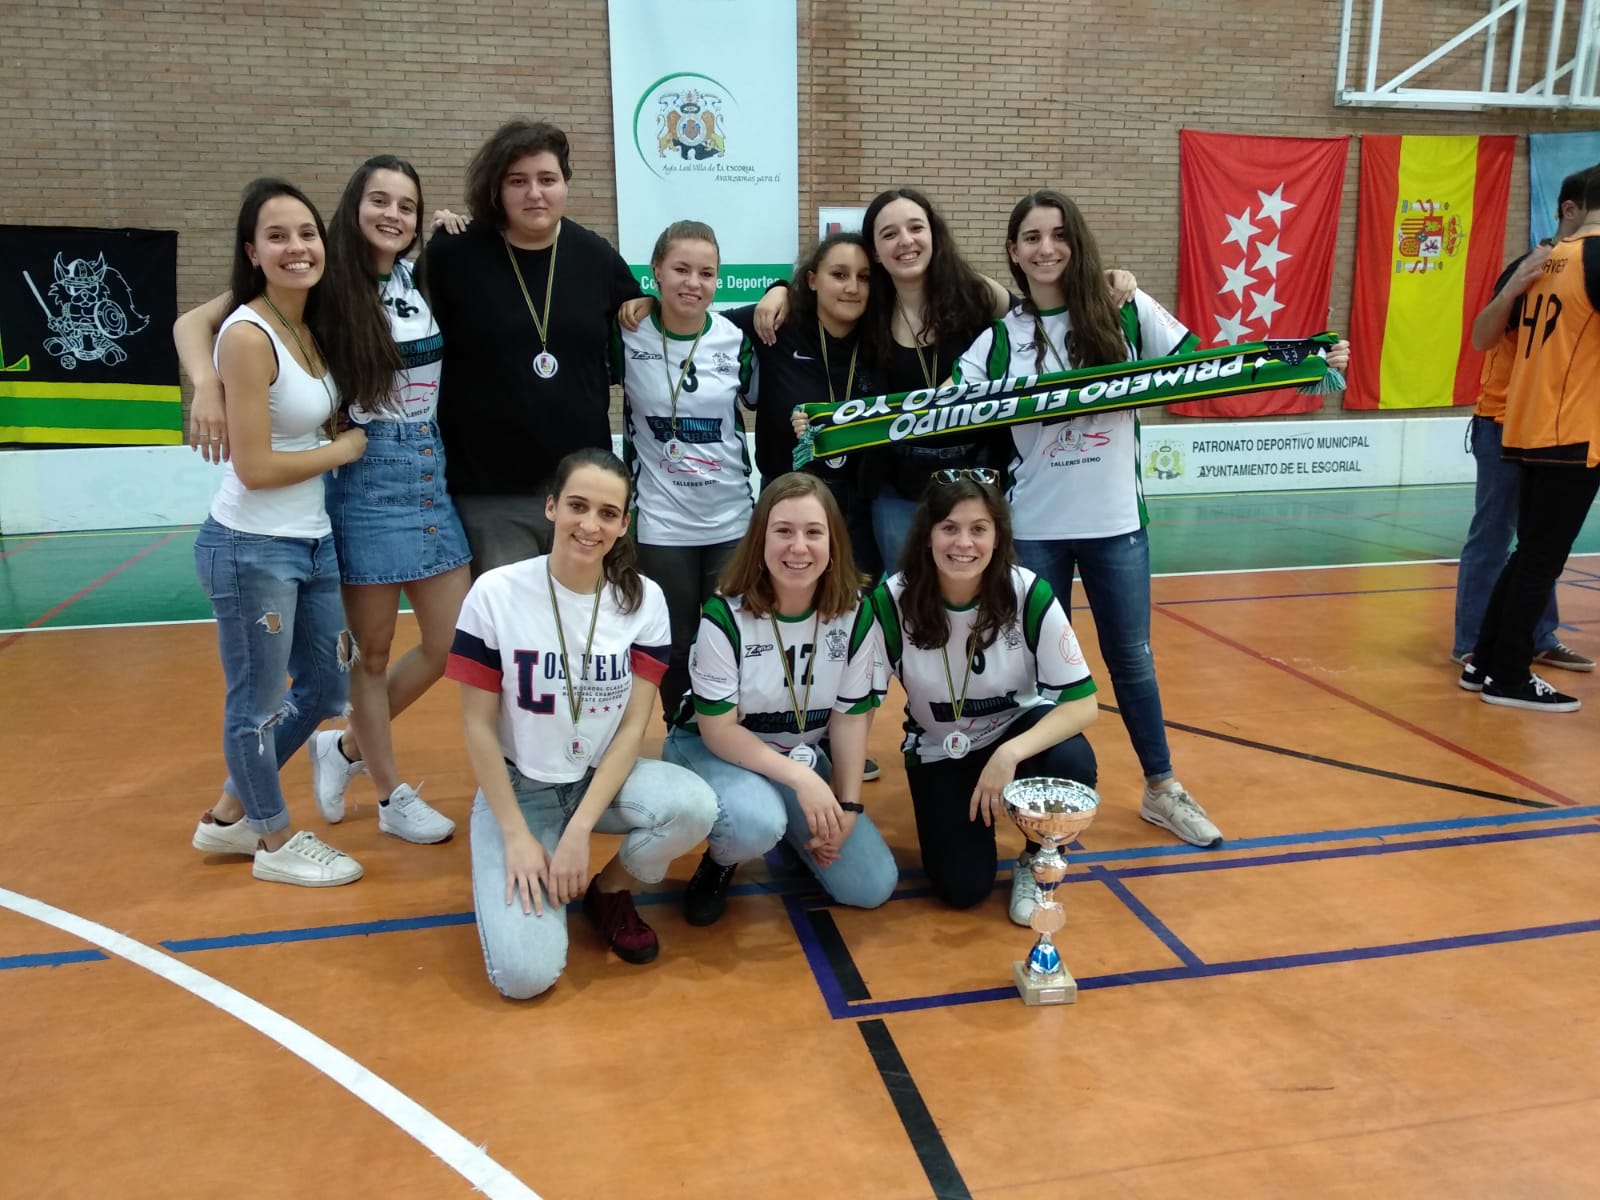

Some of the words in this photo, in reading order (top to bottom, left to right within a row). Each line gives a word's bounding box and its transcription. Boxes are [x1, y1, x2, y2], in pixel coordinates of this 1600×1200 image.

[680, 359, 699, 393] 3
[1078, 354, 1244, 404] PRIMERO
[832, 394, 892, 425] YO
[1031, 388, 1071, 413] EL
[889, 396, 1020, 441] EQUIPO
[1192, 438, 1254, 453] PATRONATO
[1256, 436, 1315, 452] DEPORTIVO
[1317, 435, 1370, 449] MUNICIPAL
[1198, 463, 1278, 478] AYUNTAMIENTO
[1280, 462, 1295, 475] DE
[1297, 462, 1309, 474] EL
[1311, 460, 1362, 473] ESCORIAL
